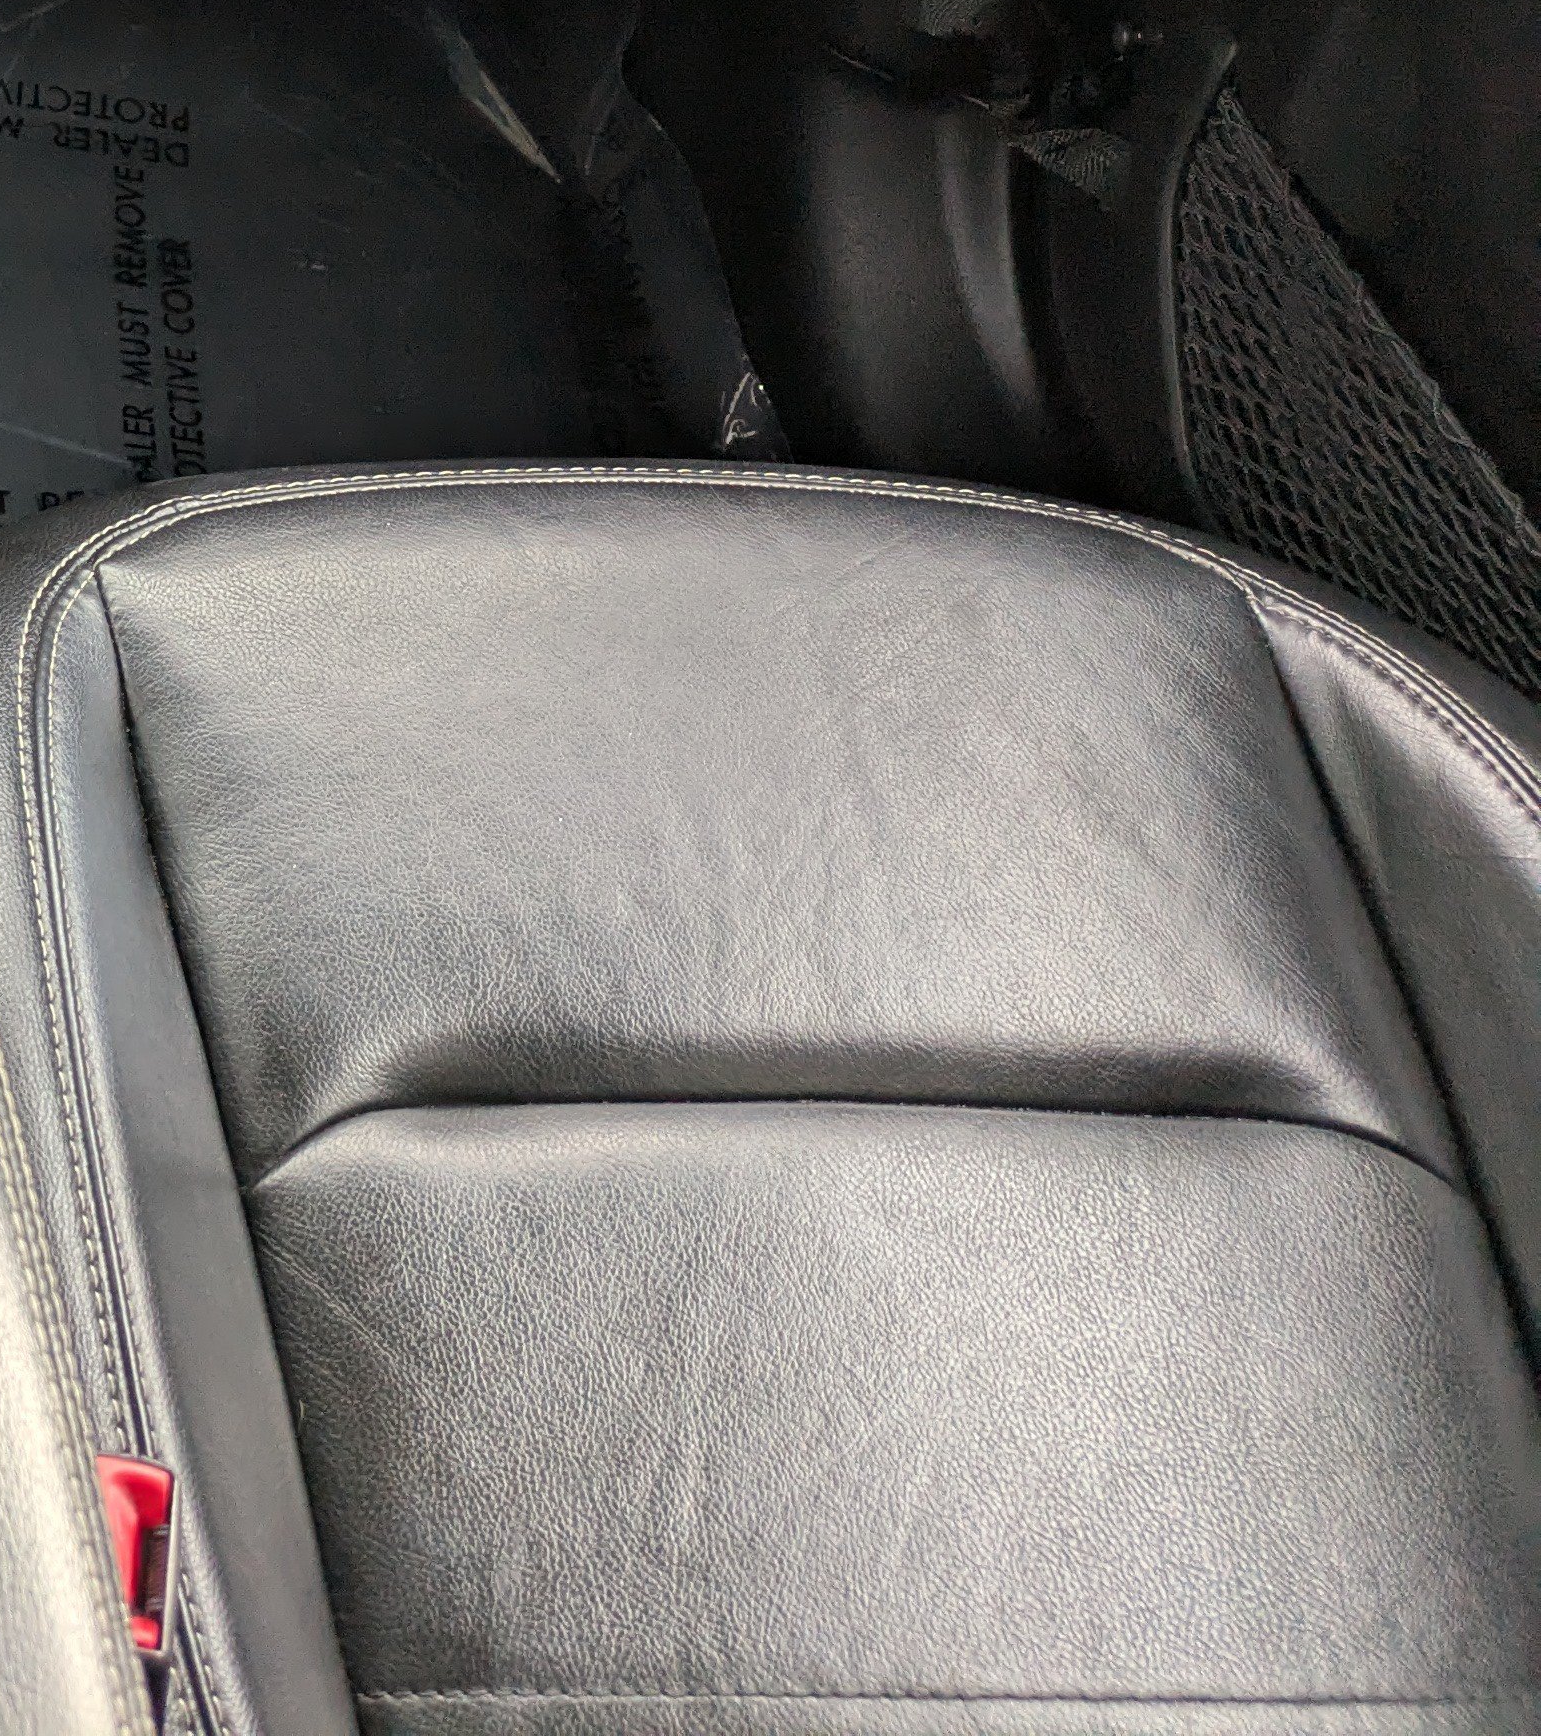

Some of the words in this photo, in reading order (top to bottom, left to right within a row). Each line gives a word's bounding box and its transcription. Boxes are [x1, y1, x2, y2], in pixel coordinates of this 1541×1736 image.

[48, 122, 190, 169] DEALER
[114, 166, 148, 288] REMOVE
[119, 301, 153, 387] MUST
